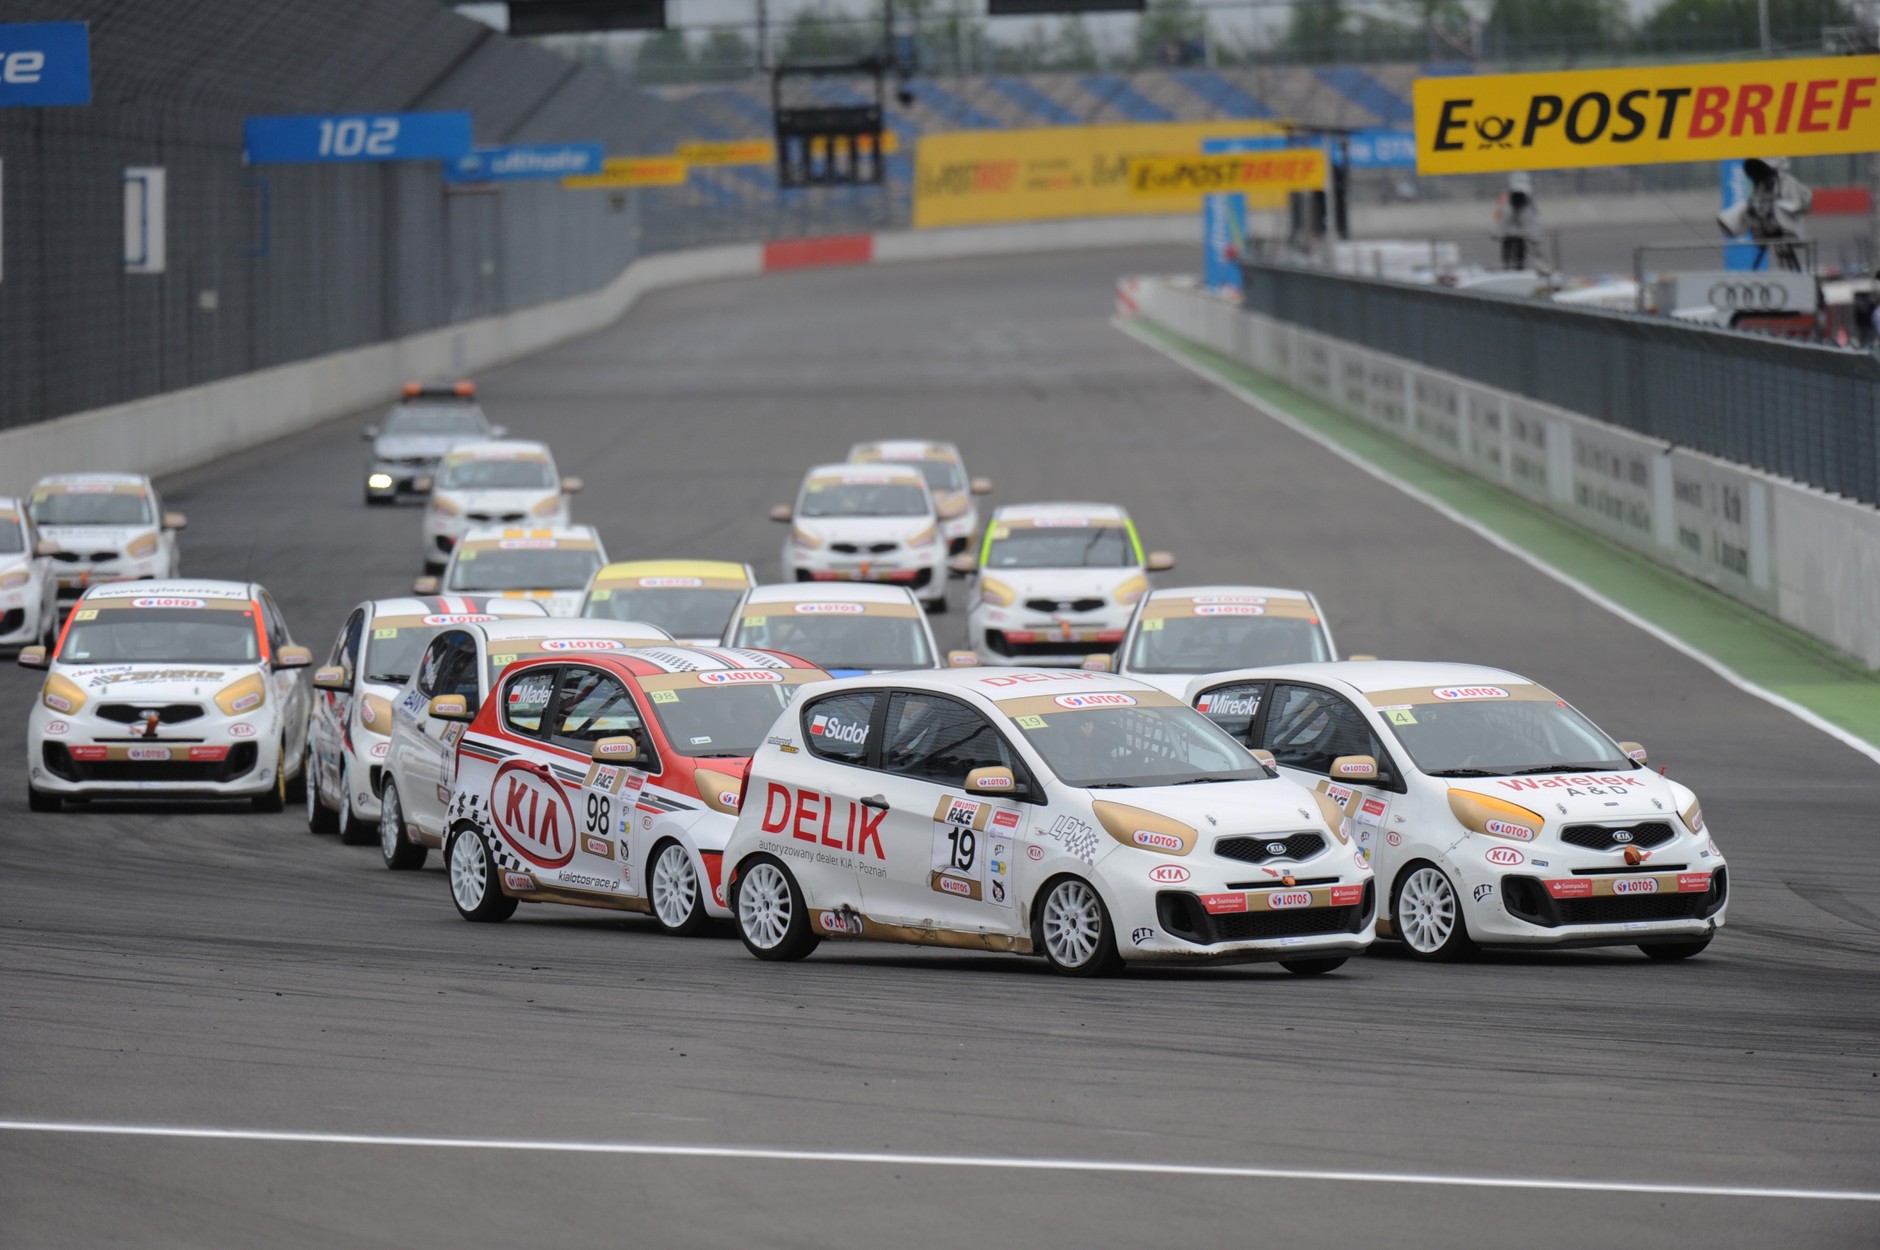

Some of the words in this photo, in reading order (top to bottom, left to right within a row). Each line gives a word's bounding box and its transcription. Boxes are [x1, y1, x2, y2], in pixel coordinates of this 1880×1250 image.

[318, 118, 400, 156] 102
[156, 599, 198, 607] LOTOS
[77, 610, 97, 621] 22
[1217, 606, 1257, 614] LOTOS
[568, 641, 616, 650] LOTOS
[727, 671, 775, 681] LOTOS
[979, 672, 1111, 687] DELIK
[519, 684, 555, 708] Madej
[653, 691, 674, 702] 98
[1457, 687, 1502, 697] LOTOS
[1083, 694, 1129, 705] LOTOS
[1208, 694, 1262, 716] Mirecki
[1021, 717, 1042, 727] 19
[1395, 711, 1408, 723] 4
[235, 724, 252, 736] KIA
[610, 745, 629, 753] LOTOS
[1350, 764, 1370, 772] LOTOS
[988, 778, 1008, 786] LOTOS
[1496, 774, 1646, 792] Wafelek
[1566, 787, 1585, 797] A
[1589, 785, 1608, 795] &
[1610, 785, 1629, 795] D
[962, 802, 978, 811] LOTOS
[505, 773, 563, 854] KIA
[586, 793, 611, 835] 98
[946, 807, 975, 826] RACE
[761, 782, 888, 860] DELIK
[1048, 814, 1092, 847] LPM
[1500, 824, 1529, 839] LOTOS
[1616, 832, 1630, 840] KIA
[1149, 834, 1178, 848] LOTOS
[1388, 833, 1400, 844] KIA
[947, 826, 976, 872] 19
[1029, 848, 1041, 858] KIA
[1270, 843, 1284, 853] KIA
[758, 839, 815, 863] autoryzowany
[816, 850, 839, 866] dealer
[840, 857, 853, 869] KIA
[859, 861, 887, 879] Poznań
[1492, 851, 1518, 864] KIA
[558, 870, 621, 891] kialotosrace.pl
[1156, 869, 1185, 880] KIA
[514, 876, 533, 890] LOTOS
[950, 880, 968, 894] LOTOS
[1561, 882, 1589, 891] Santander
[1628, 881, 1653, 892] LOTOS
[1473, 883, 1494, 902] ATT
[1216, 897, 1244, 905] Santander
[1282, 893, 1308, 905] LOTOS
[1132, 927, 1155, 945] ATT
